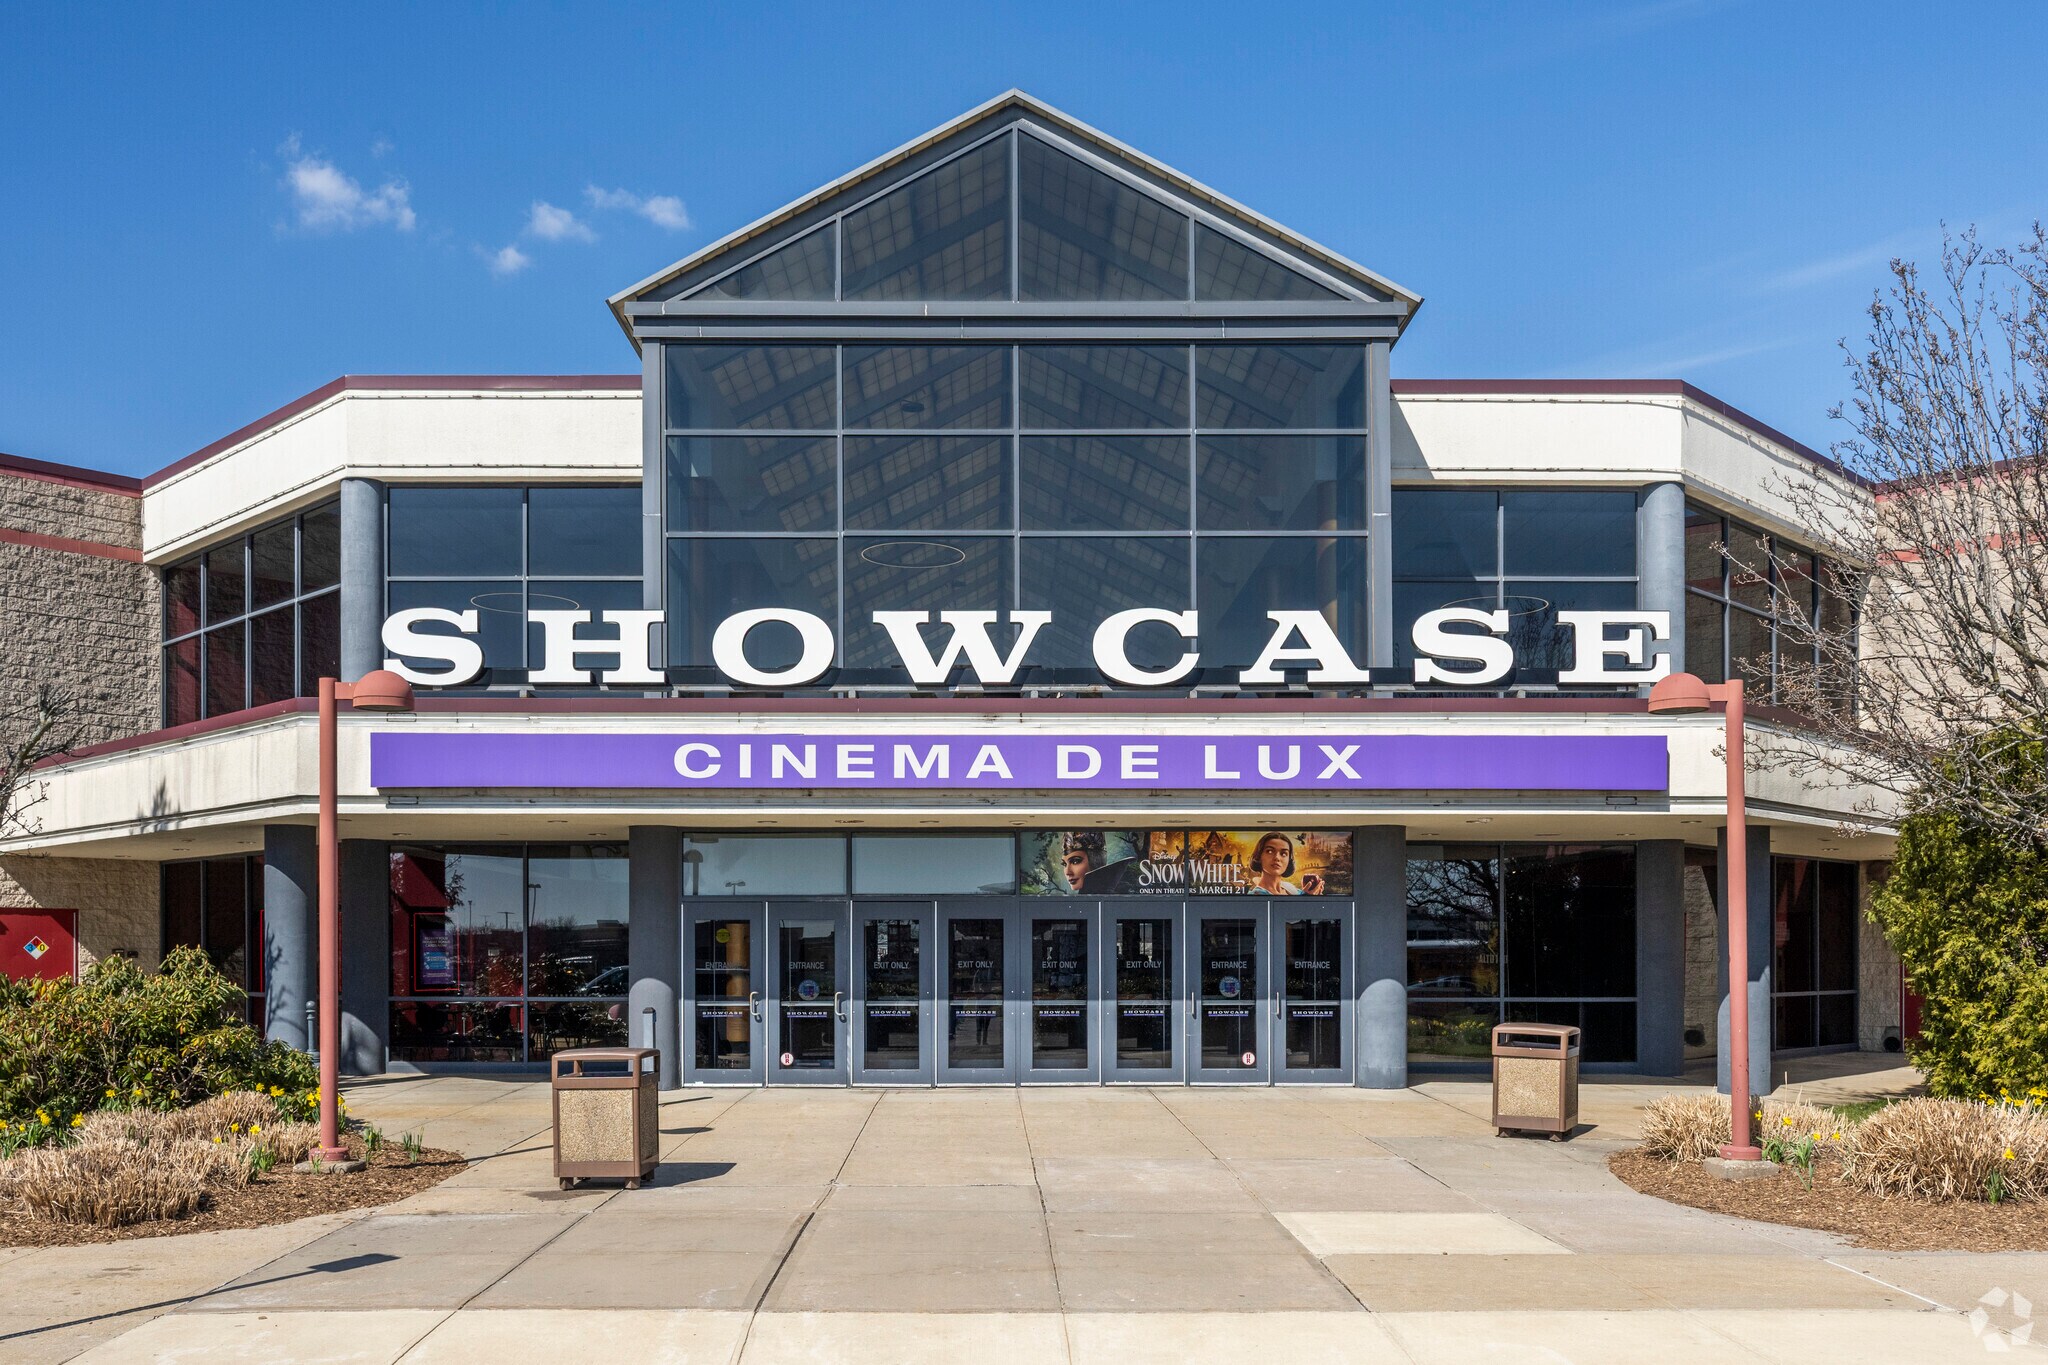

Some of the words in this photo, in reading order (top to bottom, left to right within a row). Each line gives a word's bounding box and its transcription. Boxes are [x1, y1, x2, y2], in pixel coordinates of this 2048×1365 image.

[381, 606, 1671, 687] SHOWCASE
[673, 743, 1014, 780] CINEMA
[1056, 744, 1160, 780] DE
[1204, 744, 1363, 780] LUX
[1189, 859, 1246, 885] WHITE
[1199, 886, 1233, 894] MARCH
[1235, 886, 1245, 894] 21
[789, 961, 825, 970] ENTRANCE
[873, 961, 889, 969] EXIT
[890, 961, 910, 969] ONLY
[957, 960, 974, 968] EXIT
[975, 960, 994, 968] ONLY
[1041, 961, 1058, 969] EXIT
[1059, 961, 1078, 969] ONLY
[1126, 961, 1142, 969] EXIT
[1143, 961, 1162, 969] ONLY
[1211, 961, 1248, 969] ENTRANCE
[1294, 961, 1331, 969] ENTRANCE
